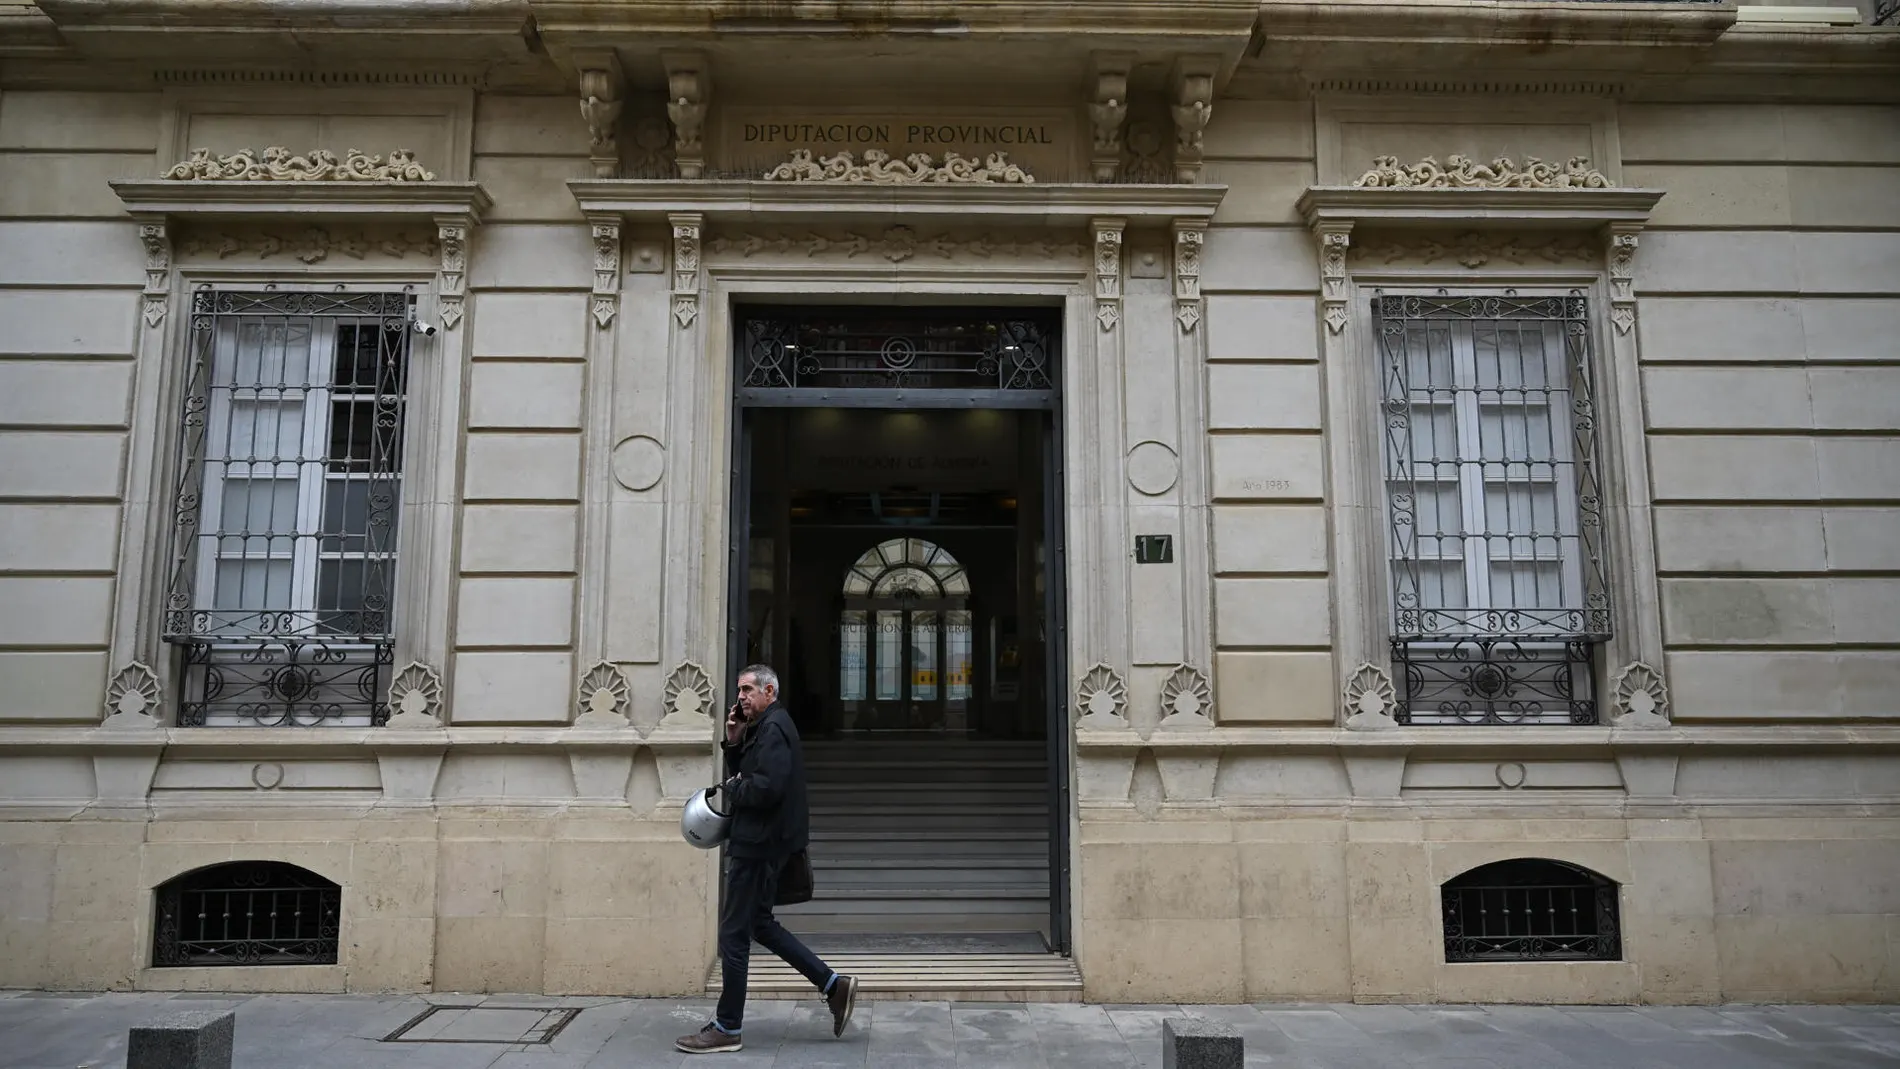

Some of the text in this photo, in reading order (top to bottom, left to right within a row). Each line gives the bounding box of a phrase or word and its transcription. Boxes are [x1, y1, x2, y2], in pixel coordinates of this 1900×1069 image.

[743, 124, 1053, 145] DIPUTACION PROVINCIAL
[1140, 536, 1169, 561] 17
